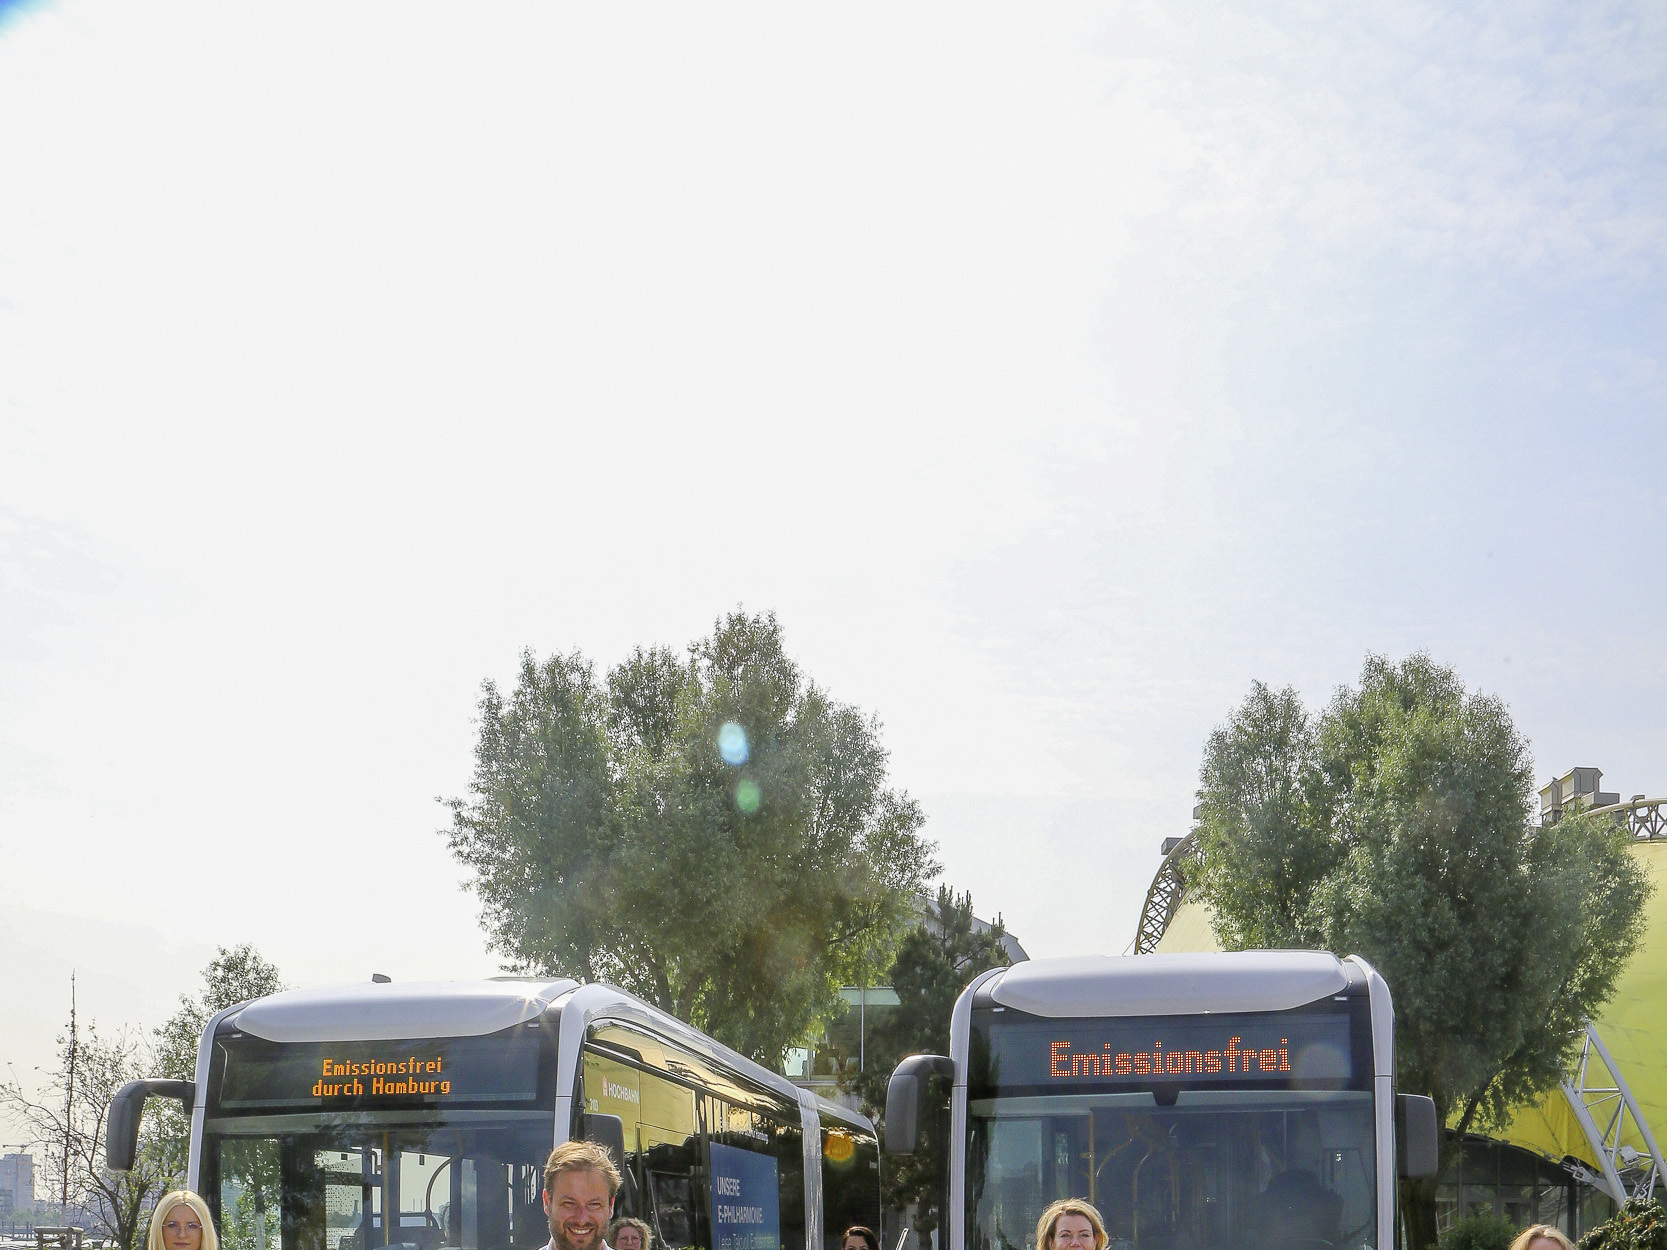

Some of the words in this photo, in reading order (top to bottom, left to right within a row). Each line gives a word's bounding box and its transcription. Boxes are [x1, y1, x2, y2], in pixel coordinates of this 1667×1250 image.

[322, 1056, 442, 1076] Emissionsfrei
[1051, 1036, 1291, 1077] Emissionsfrei
[312, 1078, 363, 1096] durch
[372, 1077, 451, 1095] Hamburg
[608, 1082, 640, 1104] HOCHBAHN
[716, 1176, 740, 1197] UNSERE
